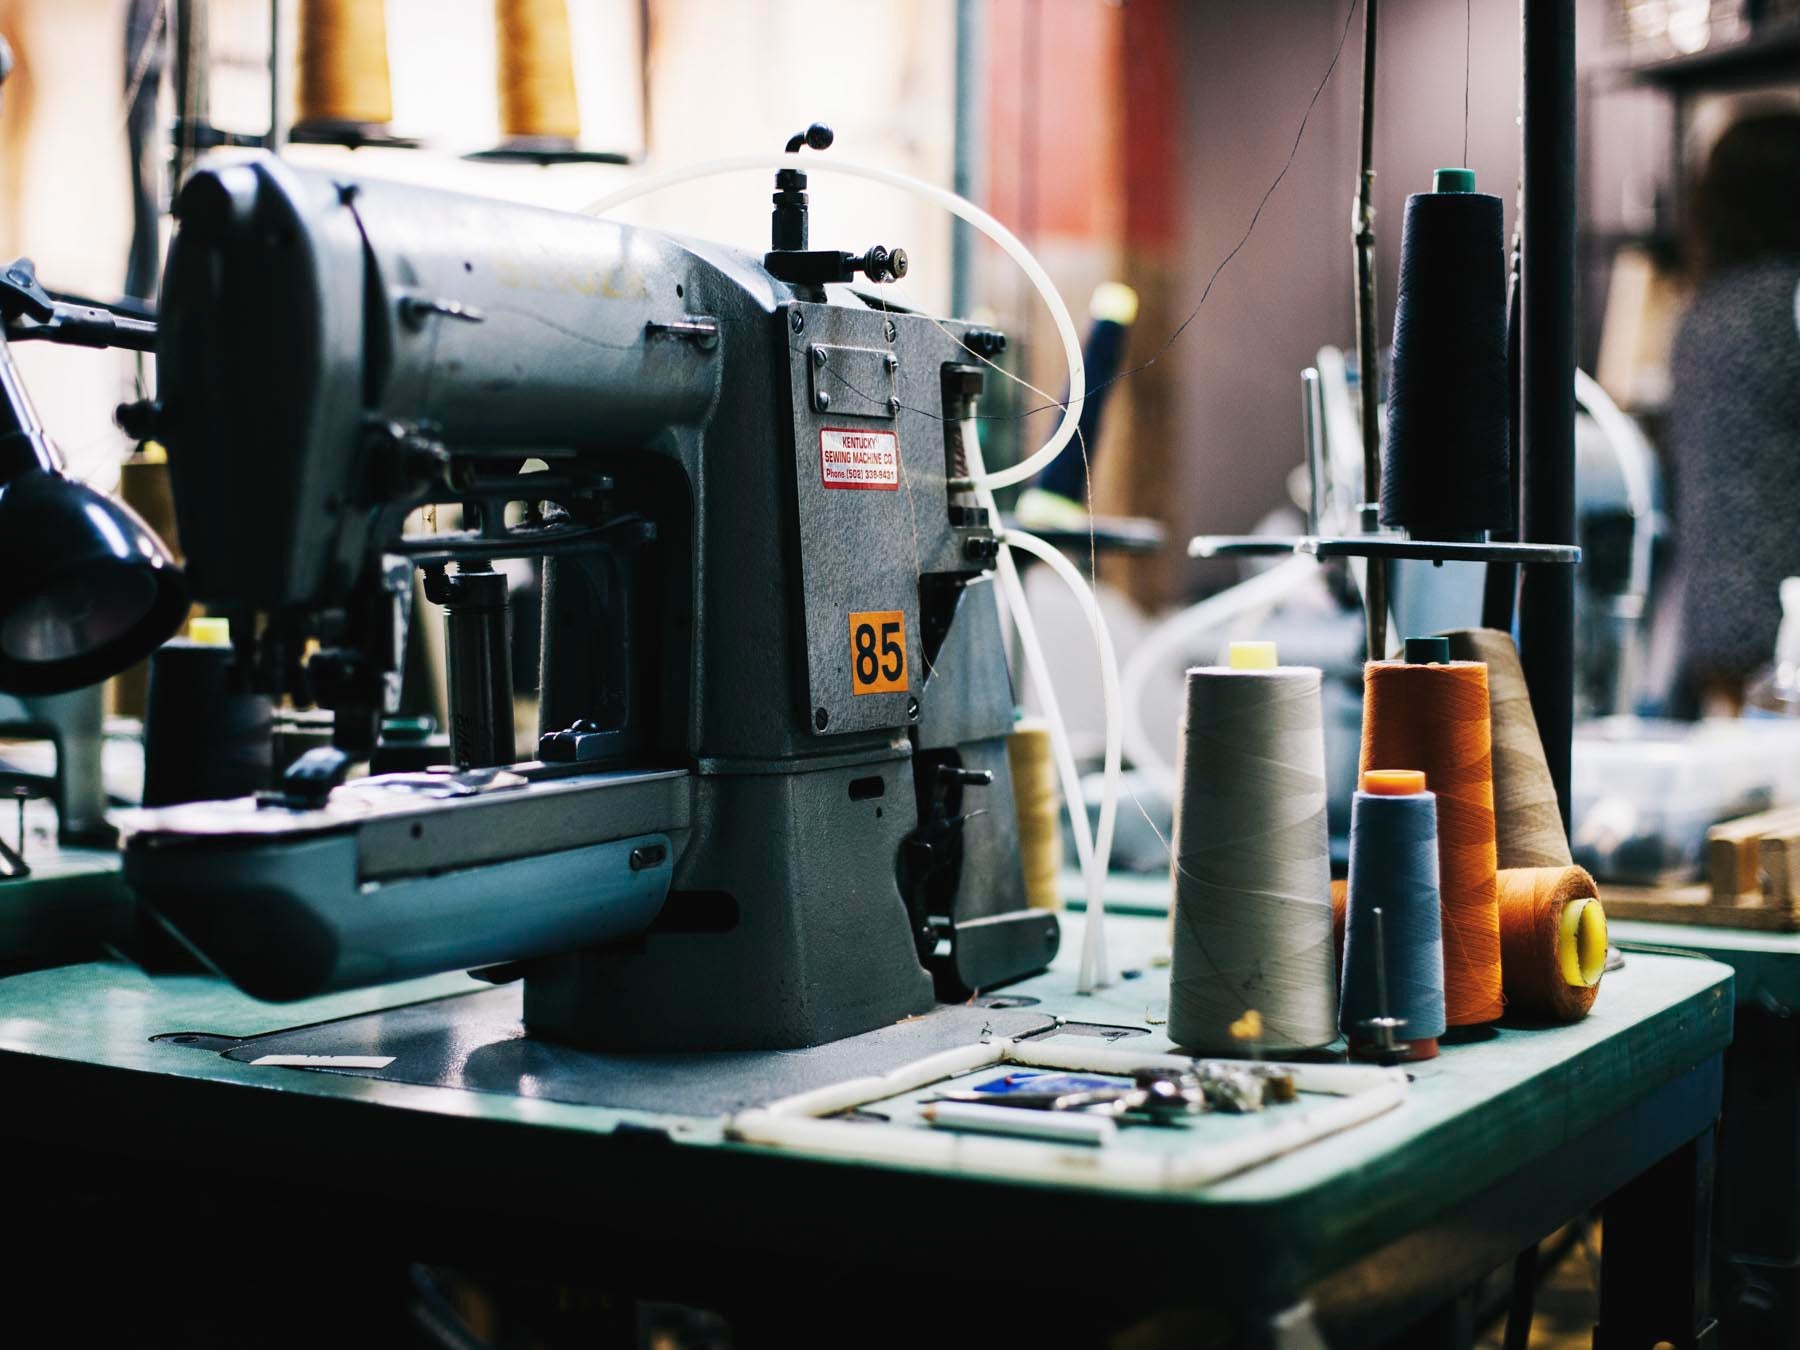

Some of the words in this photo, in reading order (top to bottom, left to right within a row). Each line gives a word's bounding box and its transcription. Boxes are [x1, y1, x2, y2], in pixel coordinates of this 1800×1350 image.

[842, 436, 876, 449] KENTUCKY
[824, 450, 851, 463] SEWING
[853, 452, 882, 464] MACHINE
[826, 468, 845, 479] Phone
[856, 622, 903, 685] 85
